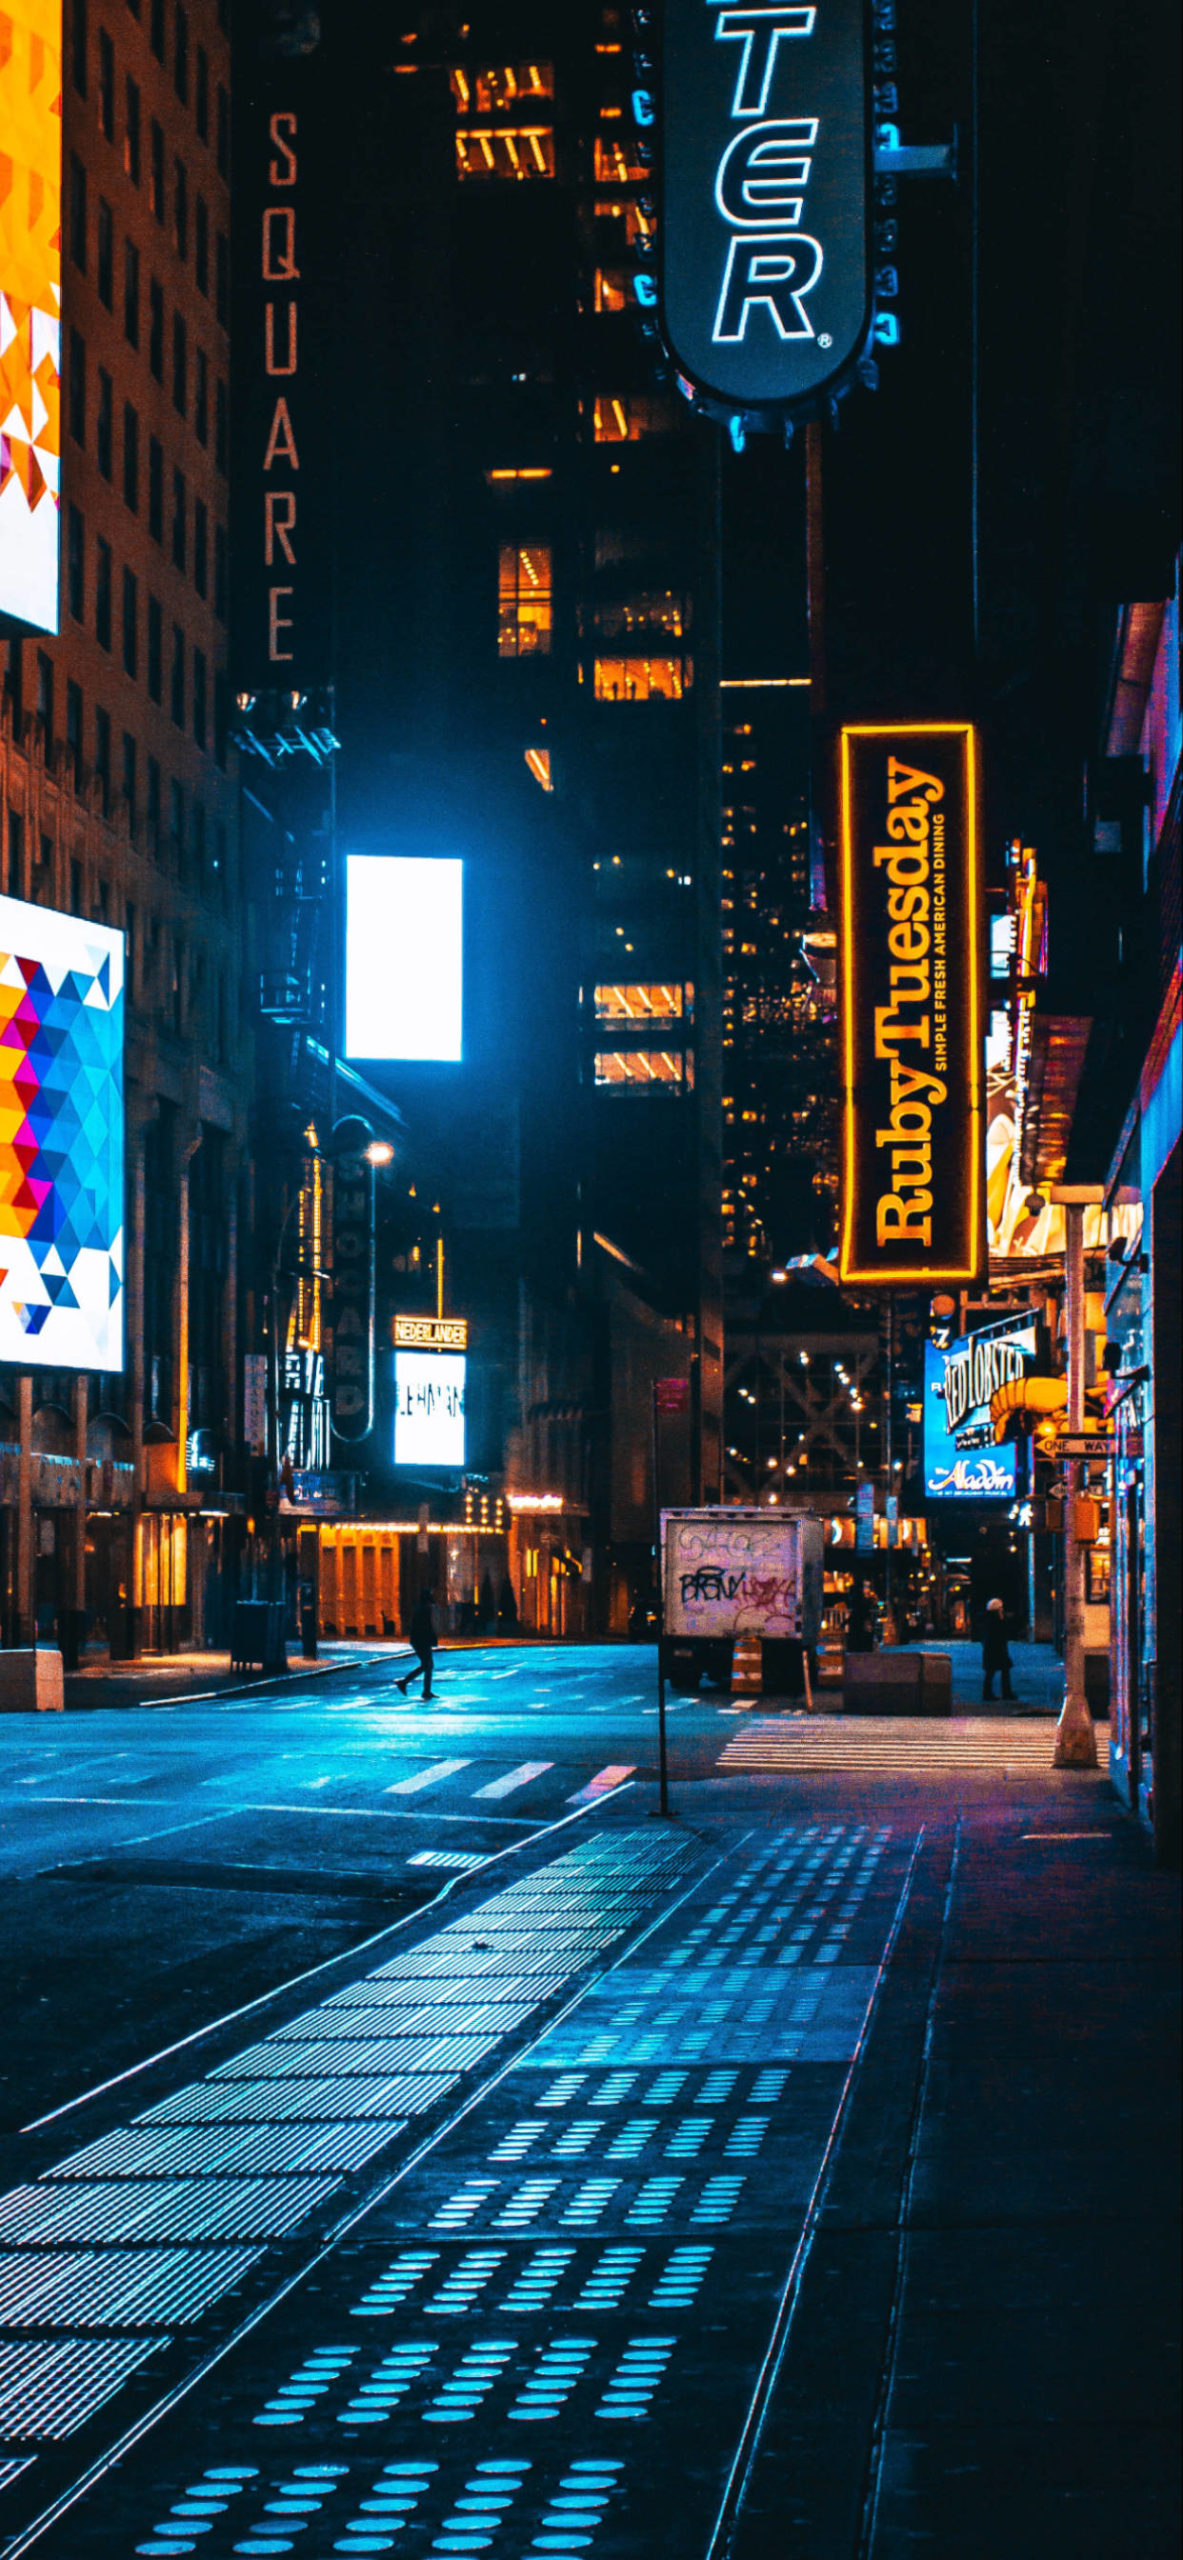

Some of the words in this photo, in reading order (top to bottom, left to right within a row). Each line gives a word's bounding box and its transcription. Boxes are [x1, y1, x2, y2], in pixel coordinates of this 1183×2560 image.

[706, 0, 823, 342] TER
[262, 113, 300, 661] SQUARE
[933, 813, 946, 869] DINING
[933, 873, 947, 955] AMERICAN
[934, 959, 947, 1009] FRESH
[934, 1013, 947, 1071] SIMPLE
[395, 1321, 466, 1343] NEDERLANDER
[945, 1359, 968, 1434] RED
[1044, 1440, 1069, 1451] ONE
[1084, 1440, 1110, 1451] WAY
[928, 1459, 1014, 1490] Aladdin
